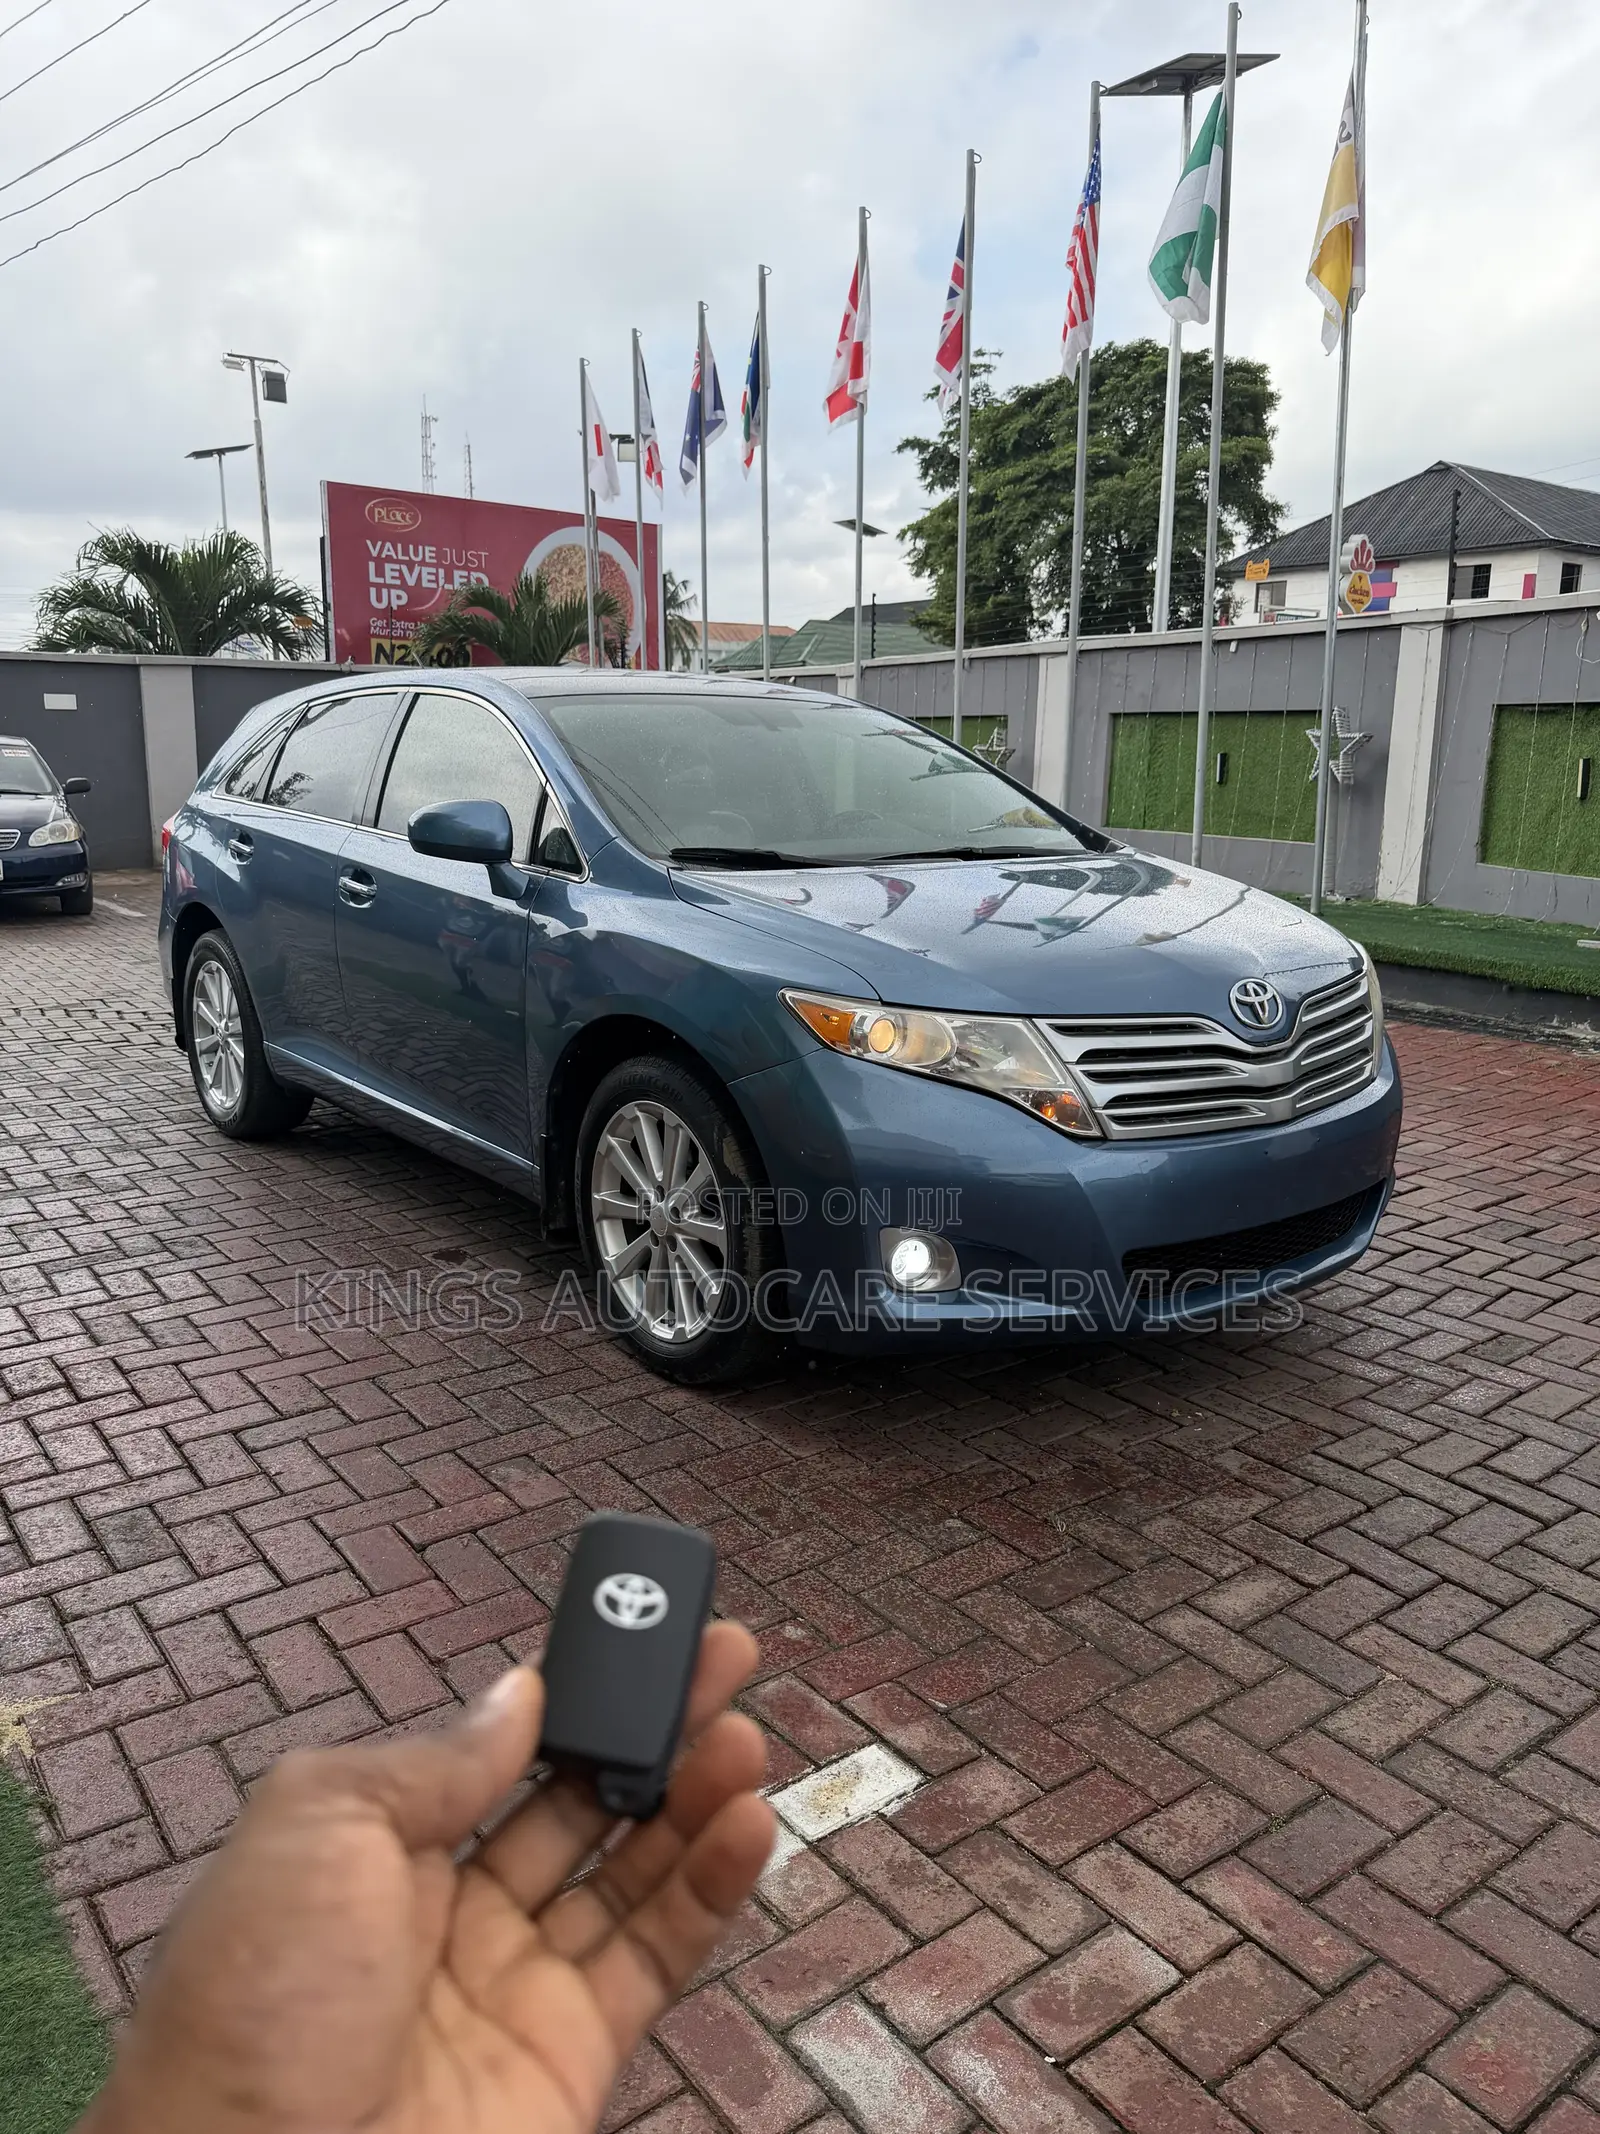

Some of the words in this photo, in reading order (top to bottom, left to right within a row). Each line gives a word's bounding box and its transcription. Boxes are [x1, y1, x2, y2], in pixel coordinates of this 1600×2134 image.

[366, 539, 437, 563] VALUE
[442, 547, 489, 569] JUST
[368, 561, 490, 591] LEVELED
[369, 587, 409, 611] UP
[370, 617, 387, 628] Get
[391, 618, 415, 630] Extra
[370, 627, 405, 638] Munch
